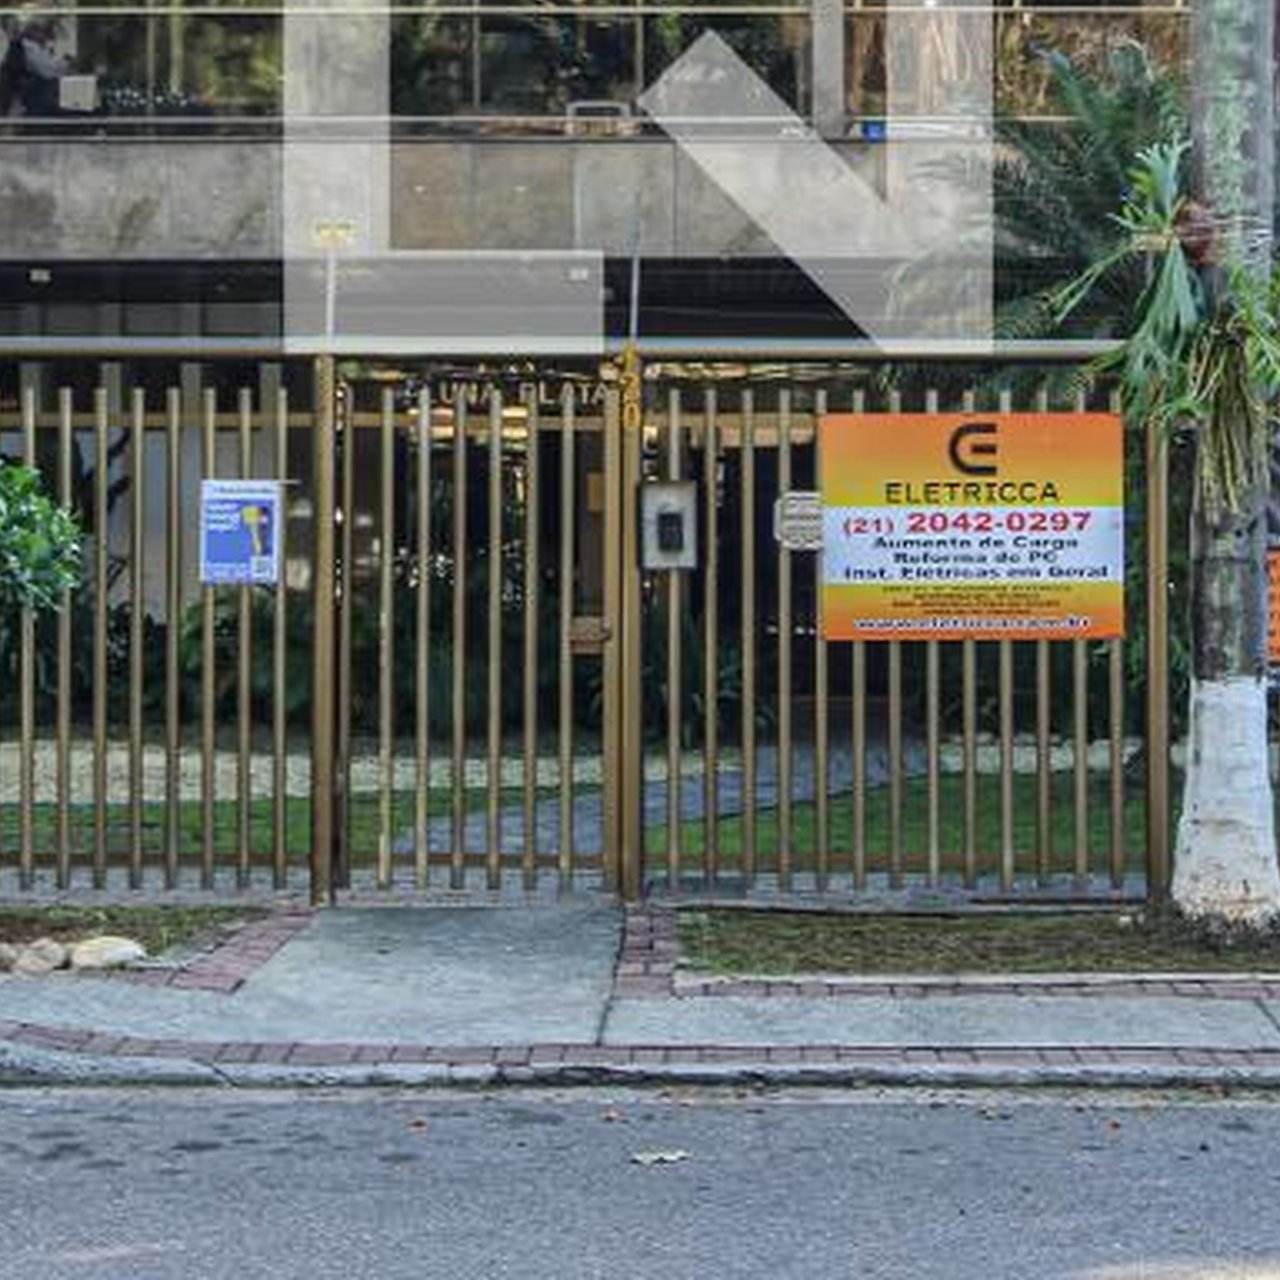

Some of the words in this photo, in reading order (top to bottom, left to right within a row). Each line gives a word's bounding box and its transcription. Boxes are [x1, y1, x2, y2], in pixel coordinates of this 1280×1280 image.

[423, 380, 499, 405] UNA
[885, 482, 1059, 504] ELETRICCA
[843, 517, 895, 535] (21)
[906, 511, 1092, 532] 2042-0297
[873, 536, 971, 549] Aumento
[1012, 535, 1078, 551] Carga
